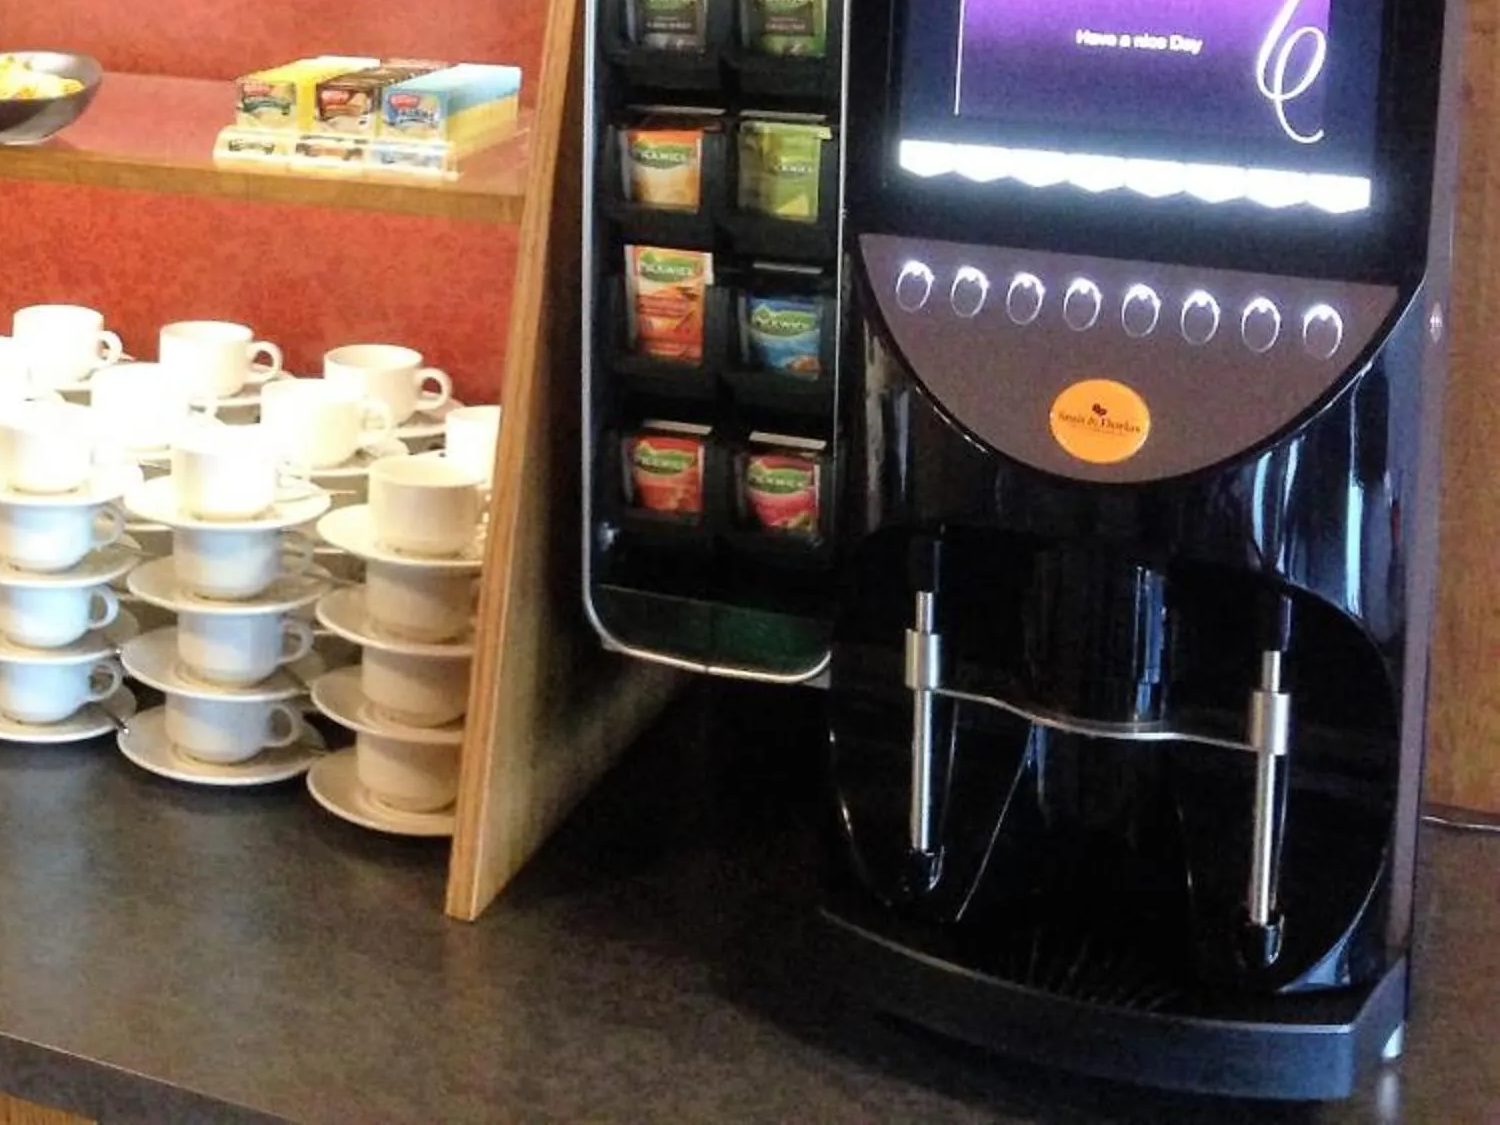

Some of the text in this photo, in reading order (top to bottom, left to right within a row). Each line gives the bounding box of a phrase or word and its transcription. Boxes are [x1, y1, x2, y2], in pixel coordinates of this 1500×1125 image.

[1076, 28, 1203, 55] Have a nice Day
